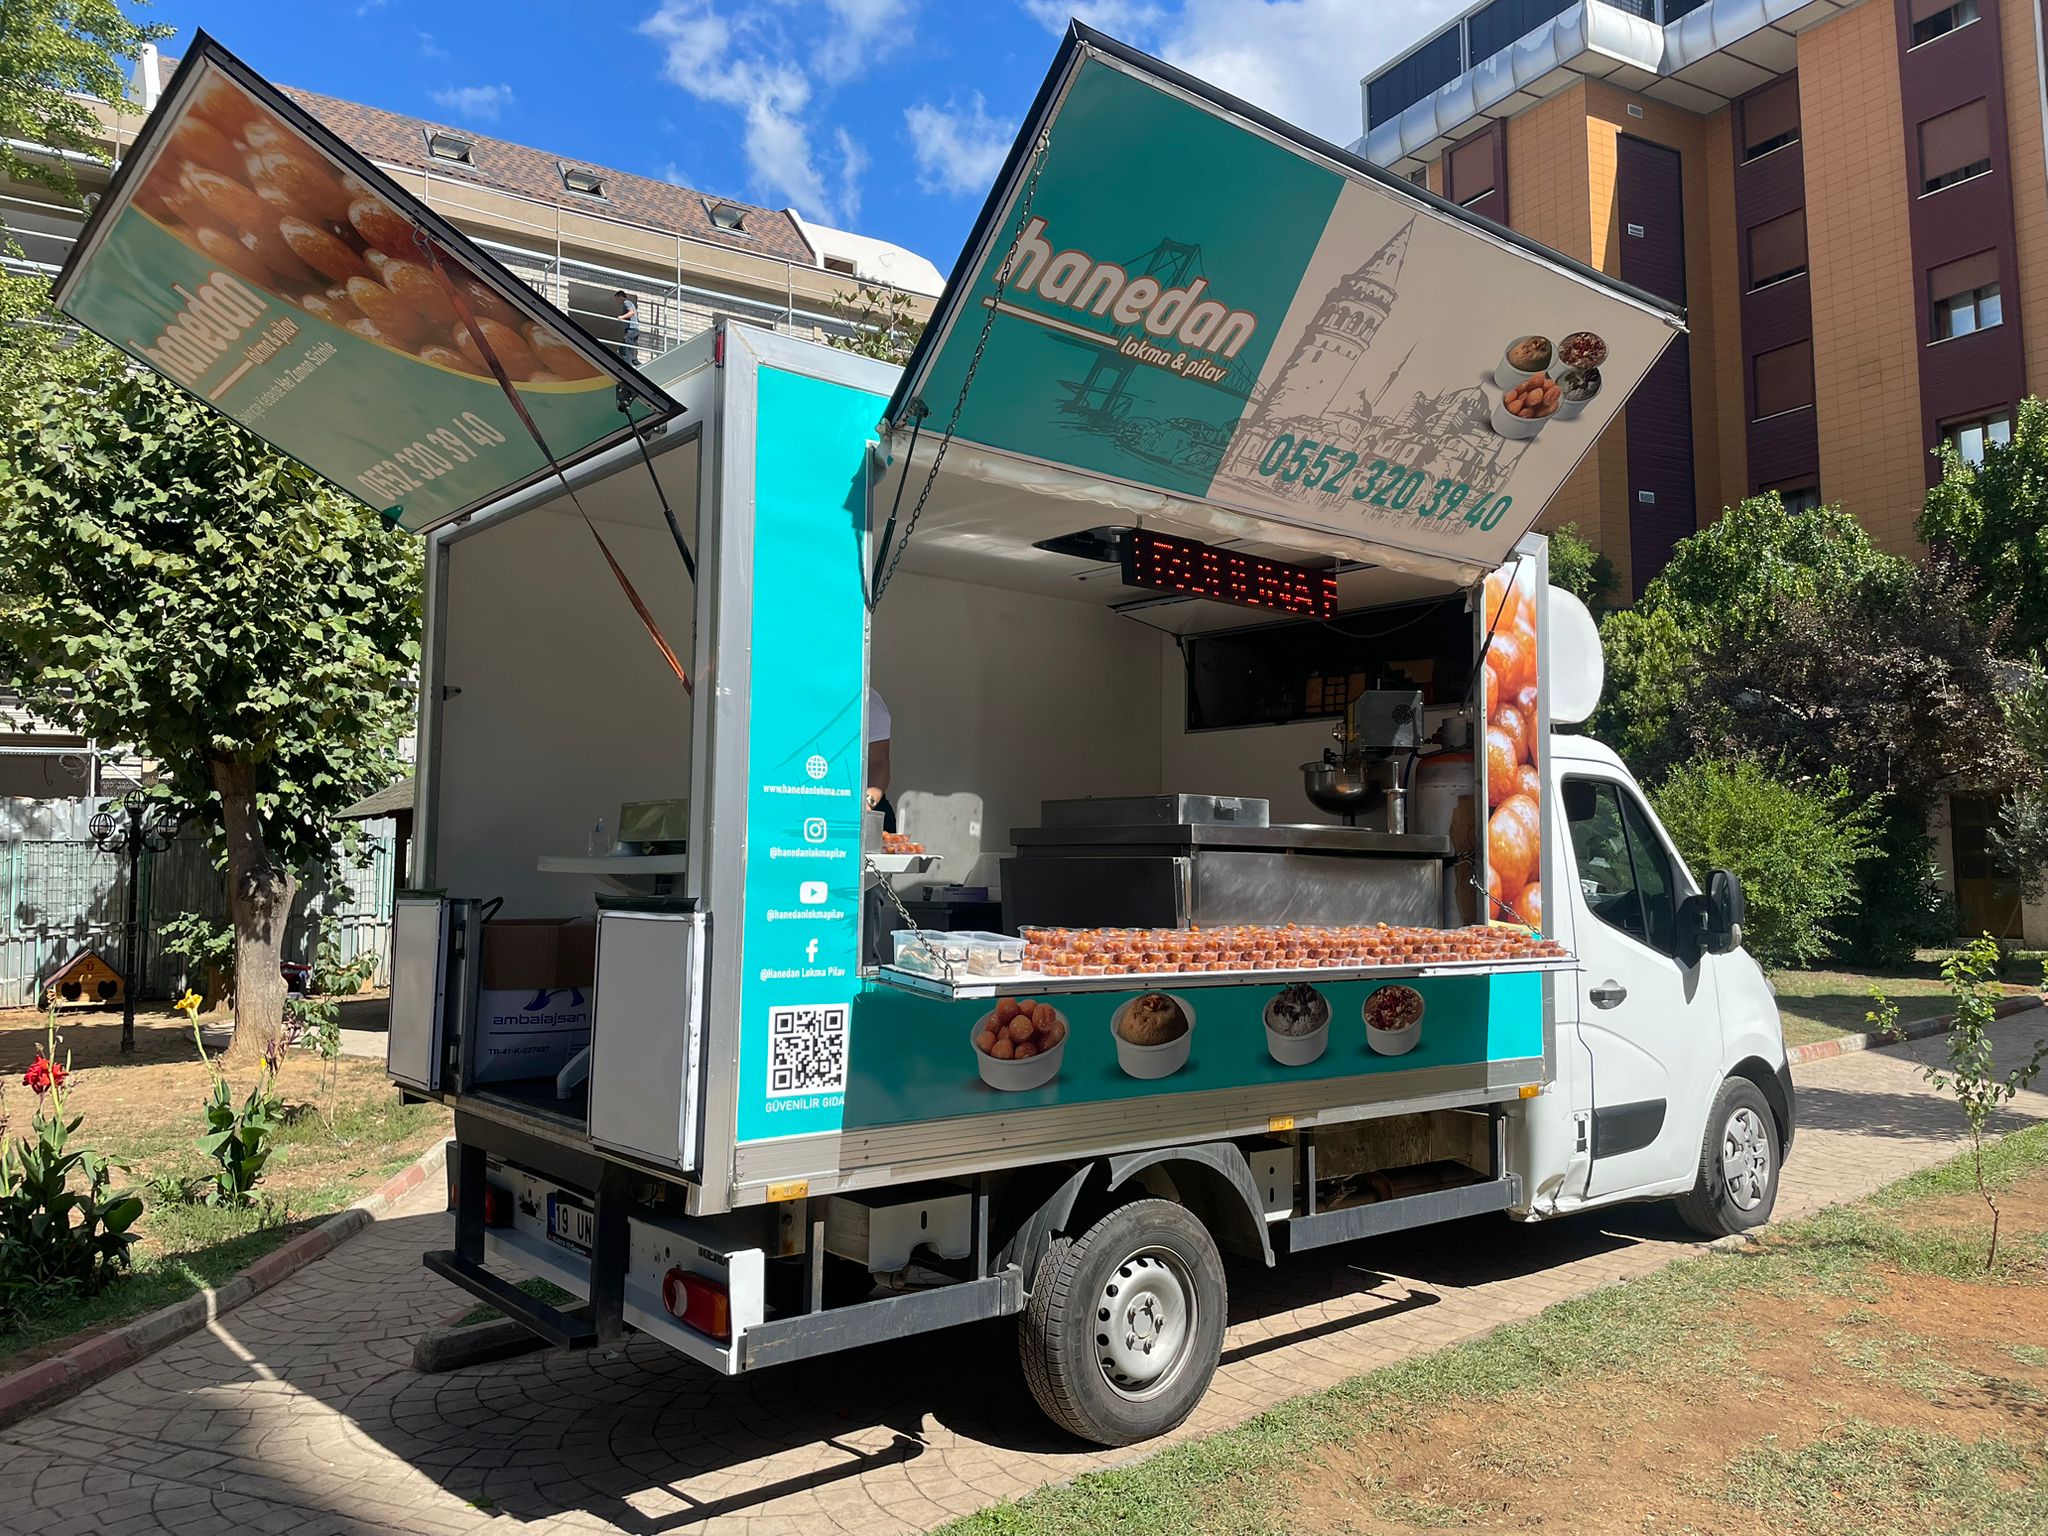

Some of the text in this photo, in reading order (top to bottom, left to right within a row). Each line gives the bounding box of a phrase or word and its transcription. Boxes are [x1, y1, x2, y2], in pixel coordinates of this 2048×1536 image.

[993, 216, 1256, 358] hanedan
[127, 271, 269, 386] hanedan
[242, 339, 277, 366] lokma
[270, 316, 299, 345] pilav
[304, 341, 338, 367] Sizinle
[1120, 335, 1227, 382] lokma & pilav
[273, 376, 297, 392] Her
[284, 359, 317, 384] Zaman
[356, 411, 506, 501] 0552 320 39 40
[1258, 434, 1513, 532] 0552 320 39 40
[763, 784, 851, 797] www.hanedanlokma.com
[769, 847, 847, 860] @hanedanlokmapilav
[767, 908, 845, 922] @hanedanlokmapilav
[760, 966, 845, 982] @Hanedan Lokma Pilav
[493, 1012, 587, 1027] ambalajsan
[765, 1095, 845, 1113] GÜVENİLİR GIDA
[556, 1205, 569, 1234] 19
[577, 1212, 593, 1245] UN
